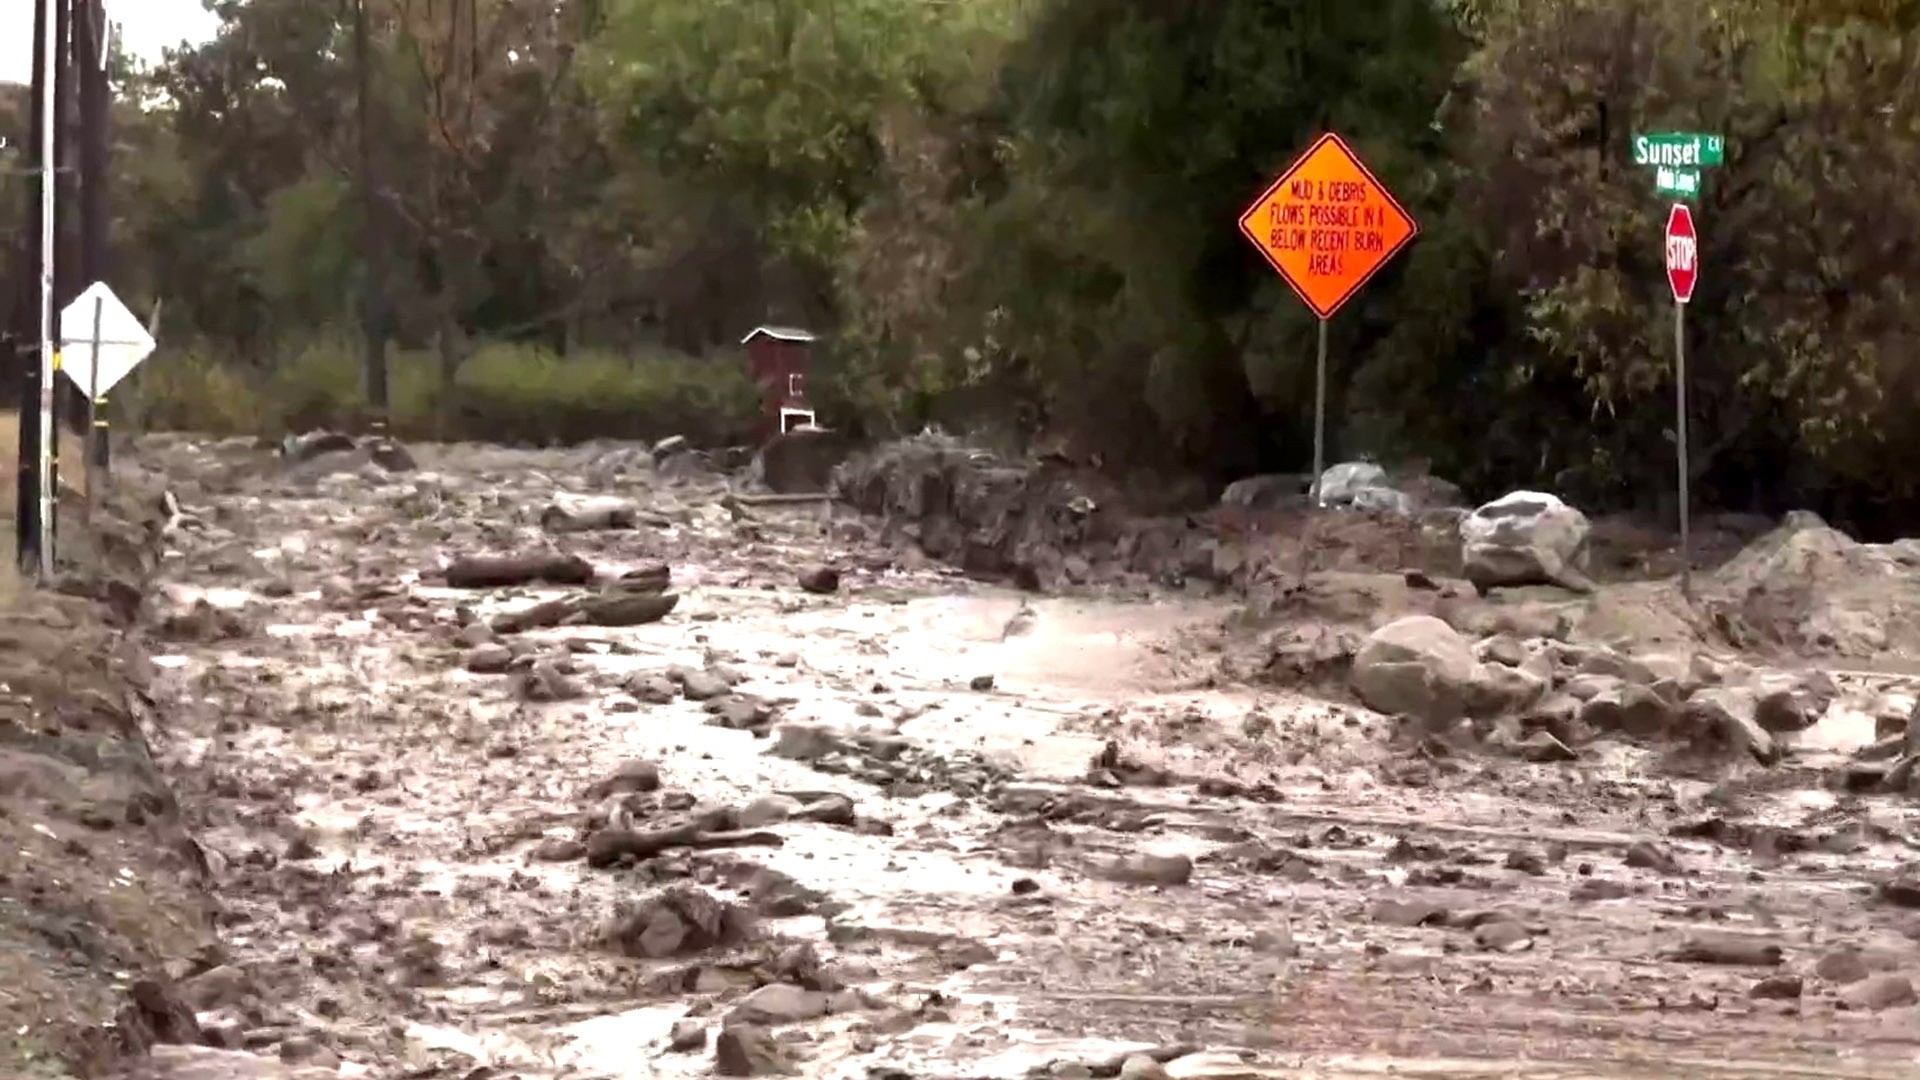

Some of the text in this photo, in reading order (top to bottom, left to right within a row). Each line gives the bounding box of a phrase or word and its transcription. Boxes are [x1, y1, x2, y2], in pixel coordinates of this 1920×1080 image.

[1636, 136, 1701, 165] Sunset
[1328, 182, 1366, 202] DEBRIS
[1270, 203, 1304, 225] FLOWS
[1309, 204, 1358, 227] POSSIBLE
[1270, 229, 1384, 251] BELOW RECENT BURN
[1669, 236, 1694, 271] STOP
